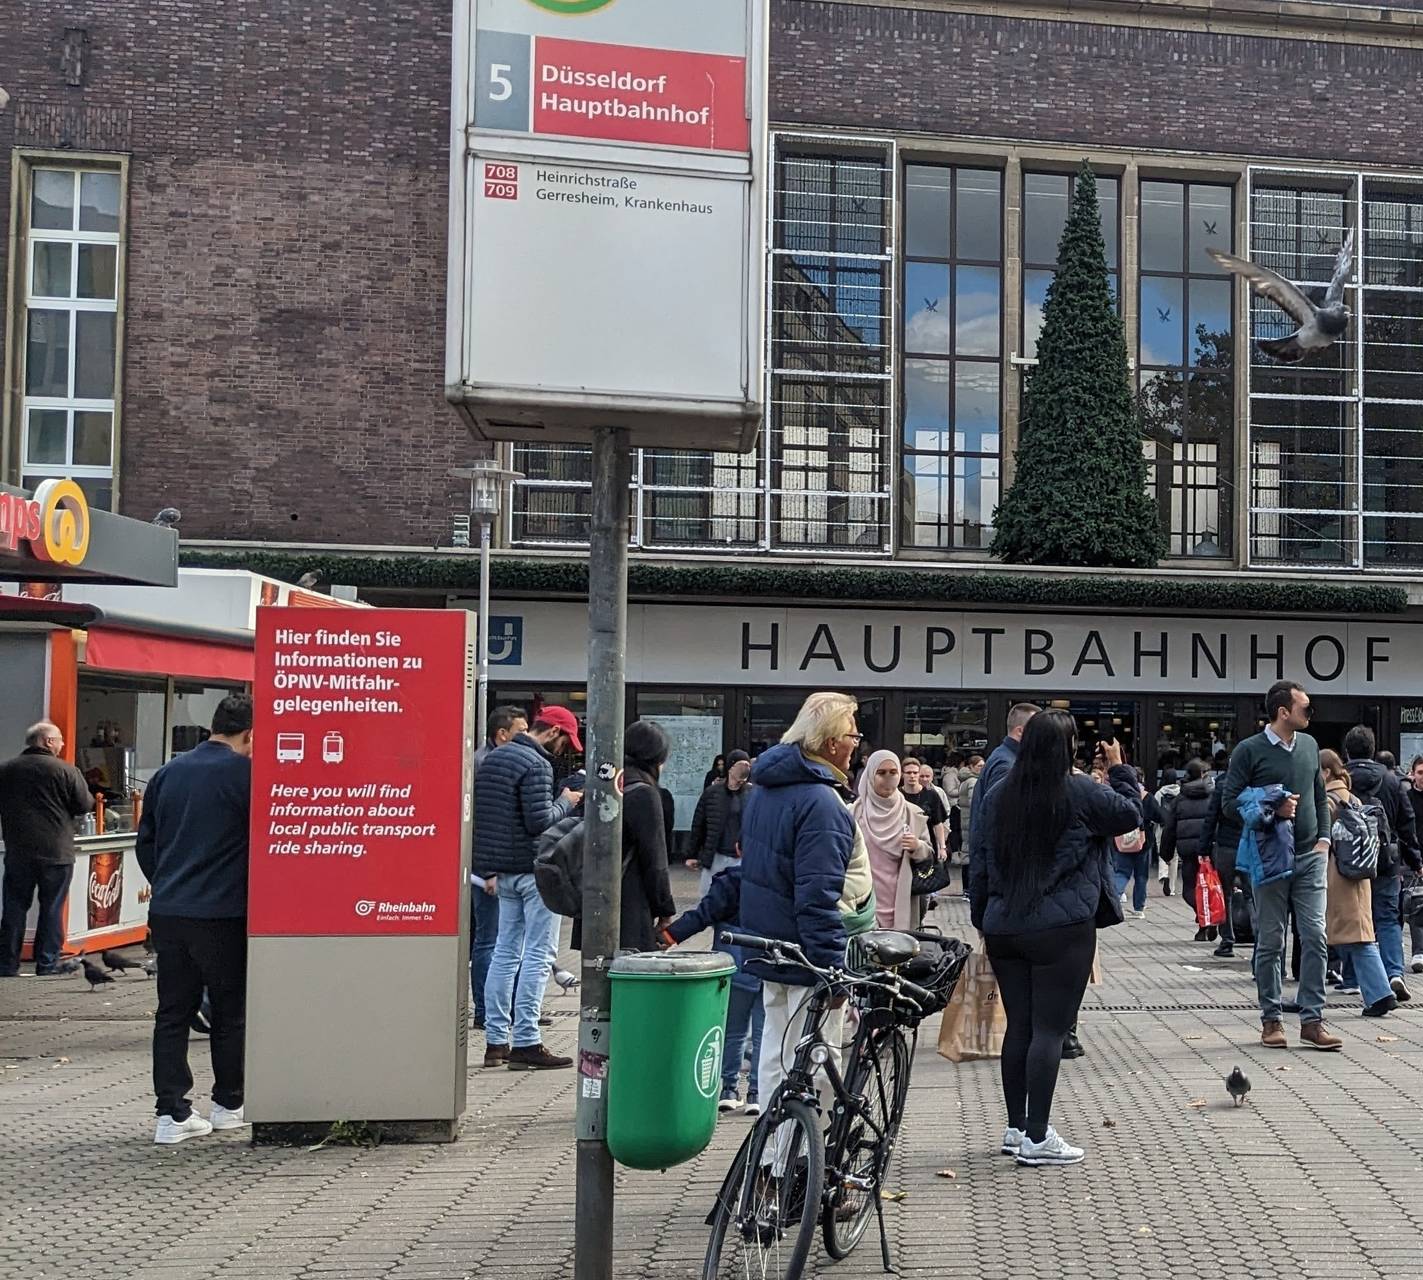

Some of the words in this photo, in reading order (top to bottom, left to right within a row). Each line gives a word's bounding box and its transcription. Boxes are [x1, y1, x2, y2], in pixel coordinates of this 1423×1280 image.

[488, 63, 514, 101] 5
[541, 64, 667, 94] Düsseldorf
[541, 92, 709, 125] Hauptbahnhof
[487, 165, 516, 180] 708
[536, 170, 638, 190] Heinrichstraße
[487, 183, 516, 198] 709
[536, 188, 619, 208] Gerresheim,
[624, 195, 714, 215] Krankenhaus
[275, 629, 311, 645] Hier
[315, 630, 371, 646] finden
[375, 631, 401, 647] Sie
[274, 652, 399, 669] Informationen
[402, 656, 422, 669] zu
[740, 622, 1391, 683] HAUPTBAHNHOF
[273, 670, 400, 691] ÖPNV-Mitfahr-
[272, 696, 403, 716] gelegenheiten.
[270, 784, 309, 798] Here
[311, 788, 343, 802] you
[346, 784, 376, 798] will
[379, 784, 411, 799] find
[269, 802, 364, 817] information
[367, 803, 415, 817] about
[268, 822, 307, 836] local
[309, 823, 359, 839] public
[361, 823, 436, 839] transport
[268, 841, 300, 855] ride
[303, 841, 367, 857] sharing.
[378, 901, 436, 912] Rheinbahn
